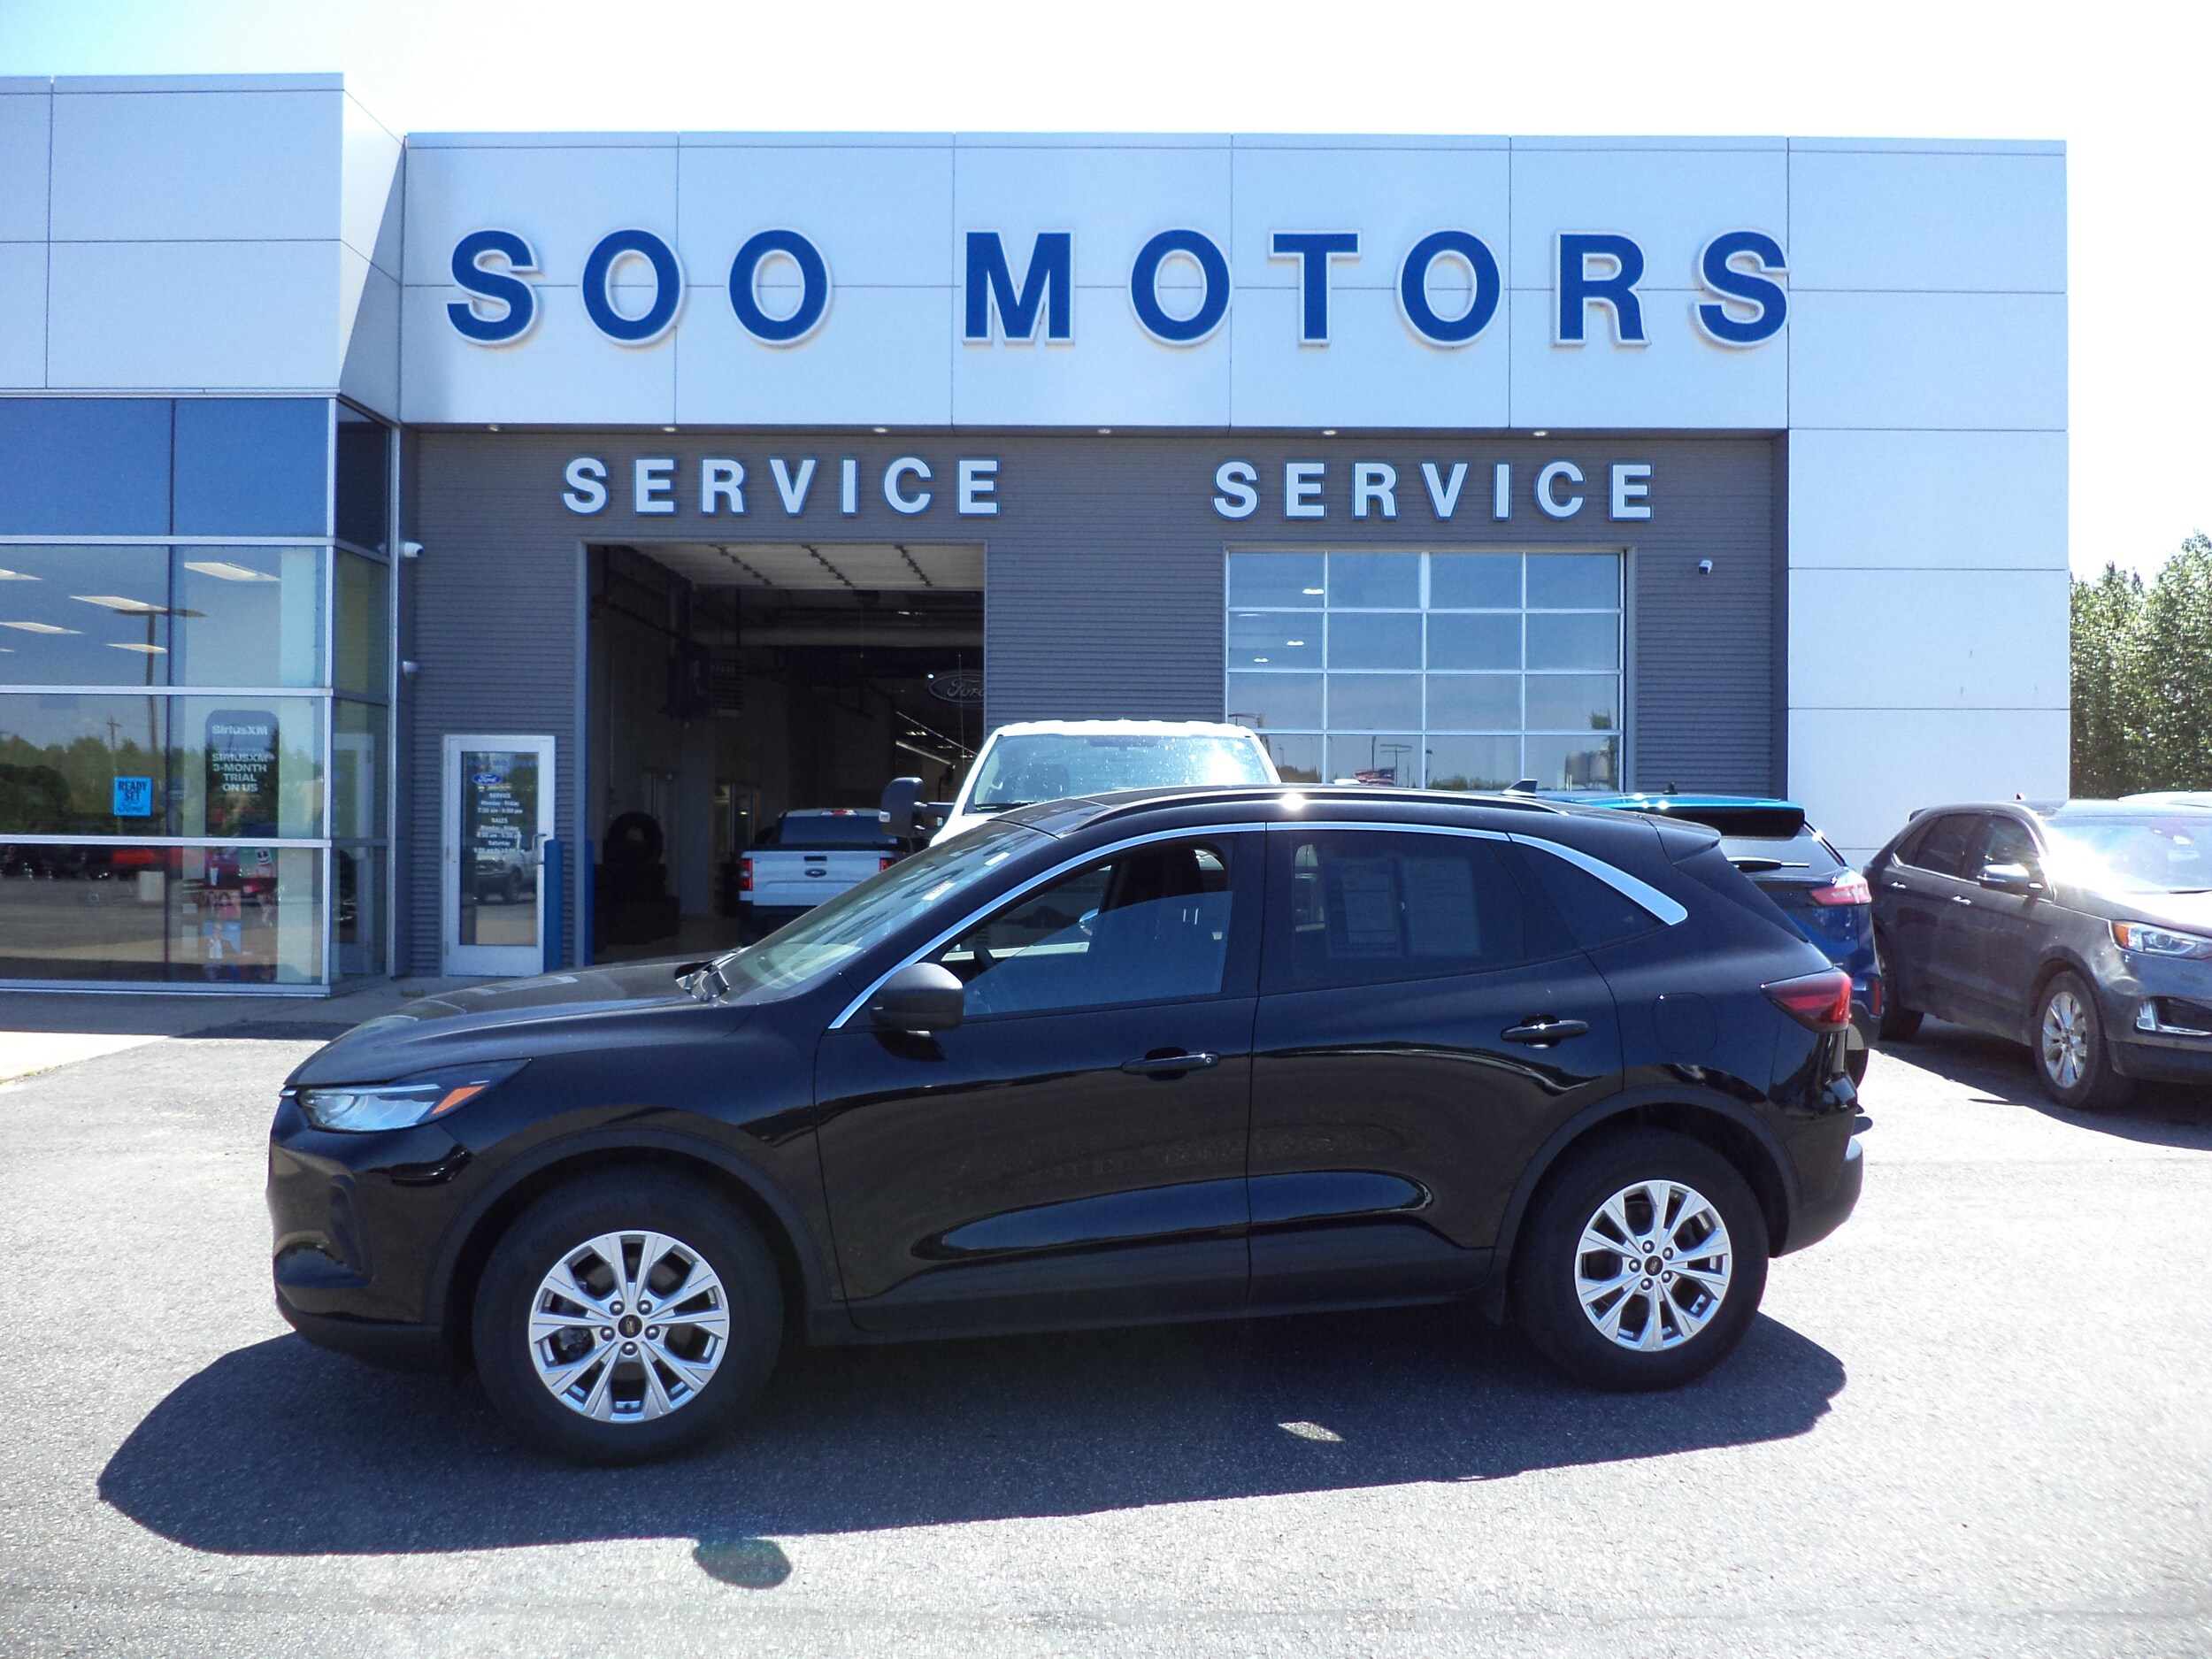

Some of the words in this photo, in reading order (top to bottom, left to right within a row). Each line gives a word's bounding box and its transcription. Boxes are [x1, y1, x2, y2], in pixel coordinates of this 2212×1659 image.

[445, 228, 831, 343] SOO
[964, 228, 1789, 344] MOTORS
[562, 457, 1001, 516] SERVICE
[1212, 460, 1655, 520] SERVICE
[212, 726, 268, 735] SiriusXM
[213, 764, 267, 772] 3-MONTH
[478, 772, 497, 784] Ford
[118, 780, 147, 791] READY
[222, 783, 240, 792] ON
[242, 783, 258, 792] US
